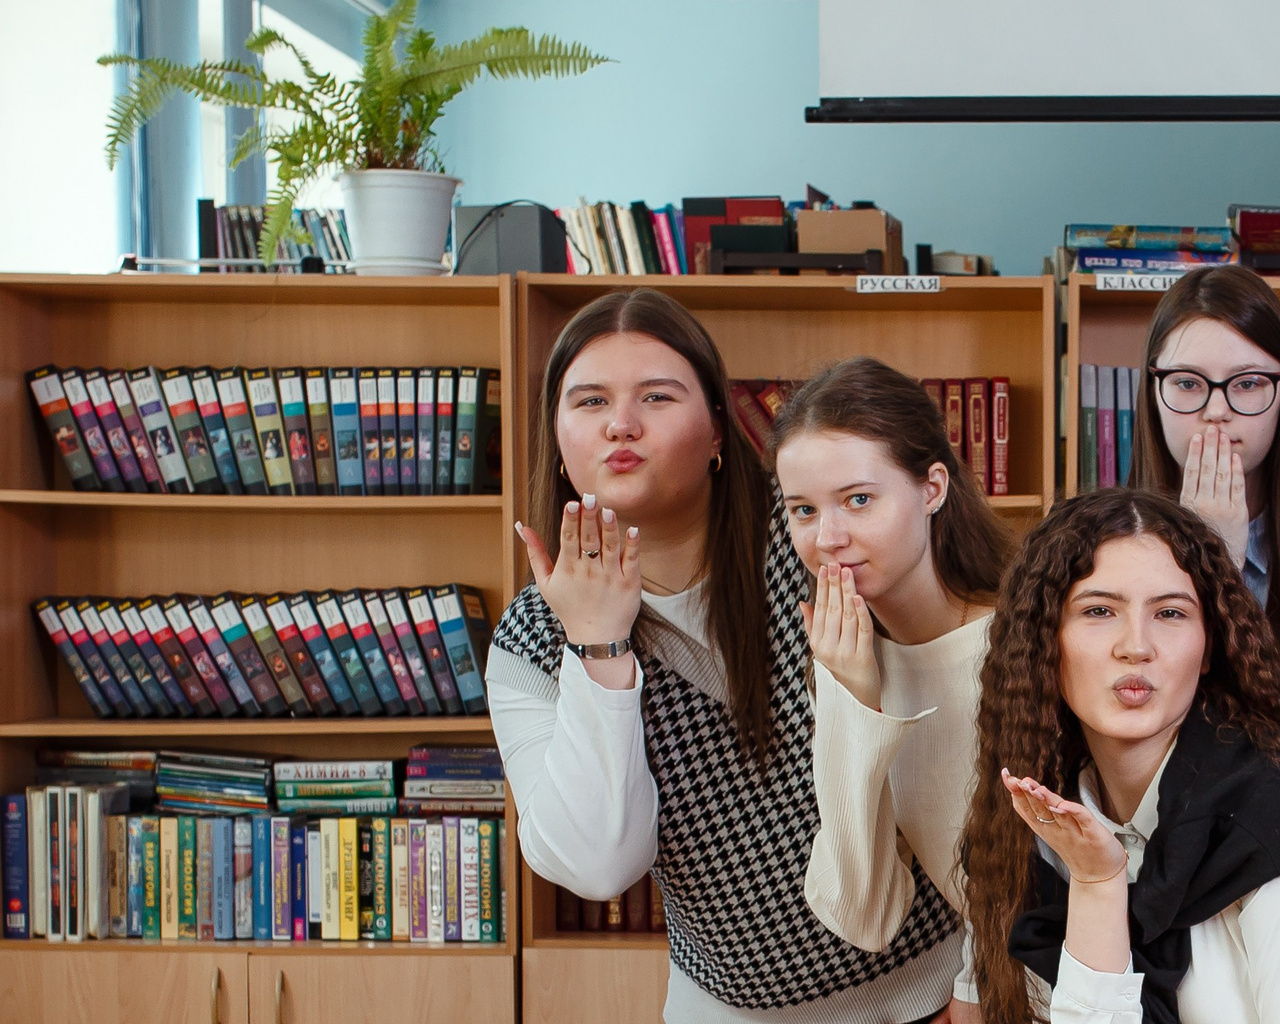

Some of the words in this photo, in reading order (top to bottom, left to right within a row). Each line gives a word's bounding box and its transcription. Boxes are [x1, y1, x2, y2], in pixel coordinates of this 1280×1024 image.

[859, 278, 939, 290] РУССКАЯ
[1102, 276, 1179, 289] КЛАССИ
[294, 765, 366, 779] ХИМИЯ-8
[375, 833, 386, 916] БИОЛОГИЯ
[464, 845, 479, 921] ХИМИЯ-8
[480, 838, 492, 920] БИОЛОГИЯ
